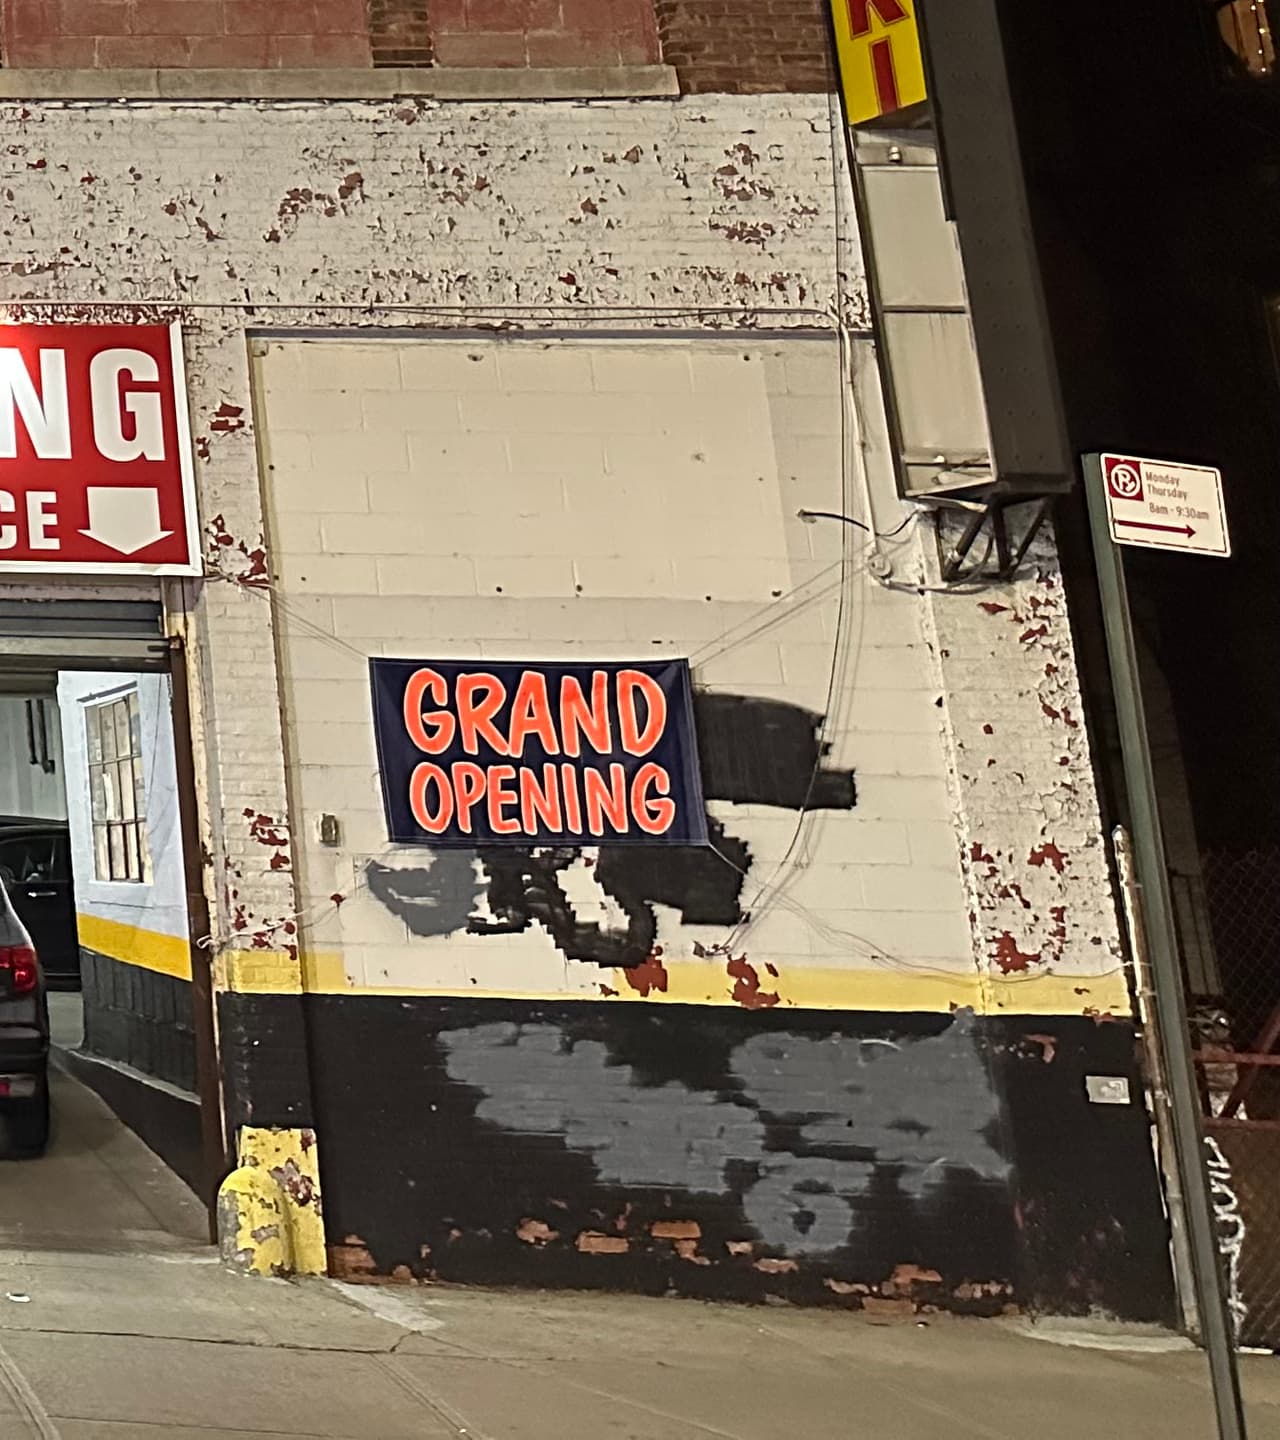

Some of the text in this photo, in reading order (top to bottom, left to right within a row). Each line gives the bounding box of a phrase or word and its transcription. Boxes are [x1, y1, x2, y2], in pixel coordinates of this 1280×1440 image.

[1145, 471, 1180, 488] Monday
[1147, 483, 1188, 501] Thursday
[1149, 502, 1169, 515] 8am
[1175, 506, 1210, 520] 9:30am
[403, 667, 667, 758] GRAND
[408, 762, 677, 837] OPENING
